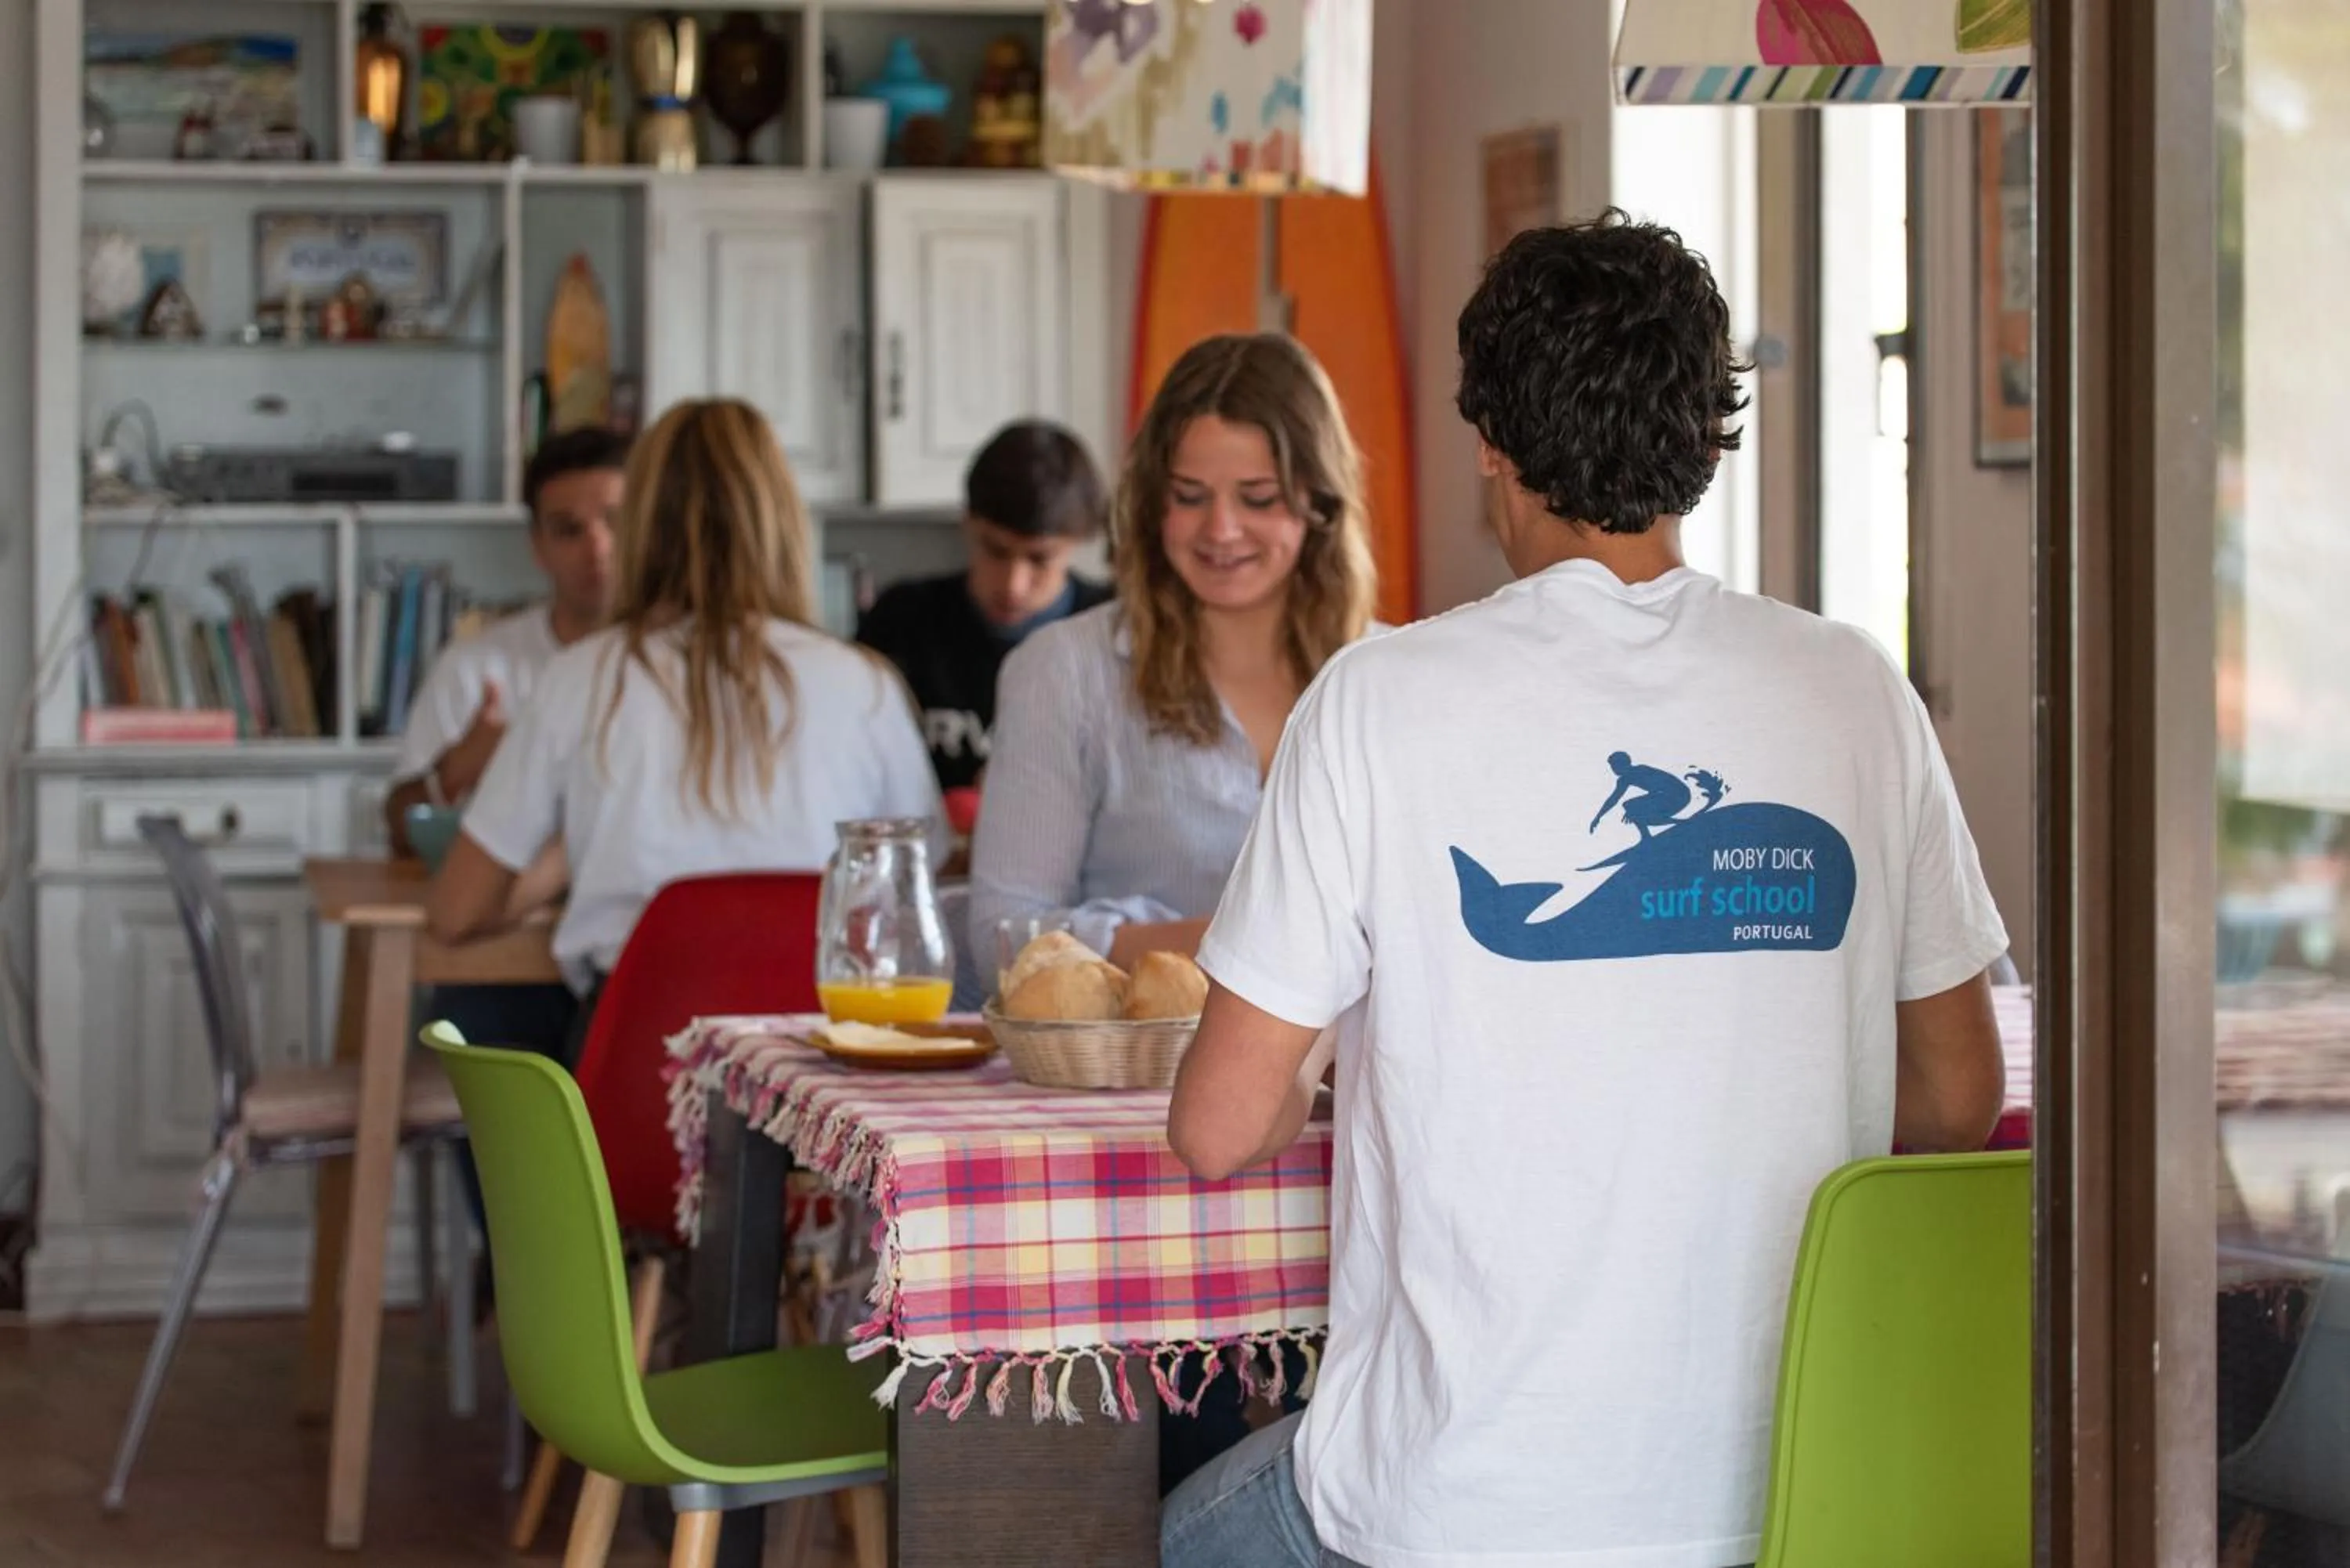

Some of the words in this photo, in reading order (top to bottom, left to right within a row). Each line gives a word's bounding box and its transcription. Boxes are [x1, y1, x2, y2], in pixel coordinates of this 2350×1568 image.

[1713, 847, 1767, 871] MOBY
[1772, 847, 1814, 870] DICK
[1641, 876, 1703, 919] surf
[1712, 874, 1815, 916] school
[1734, 924, 1813, 940] PORTUGAL
